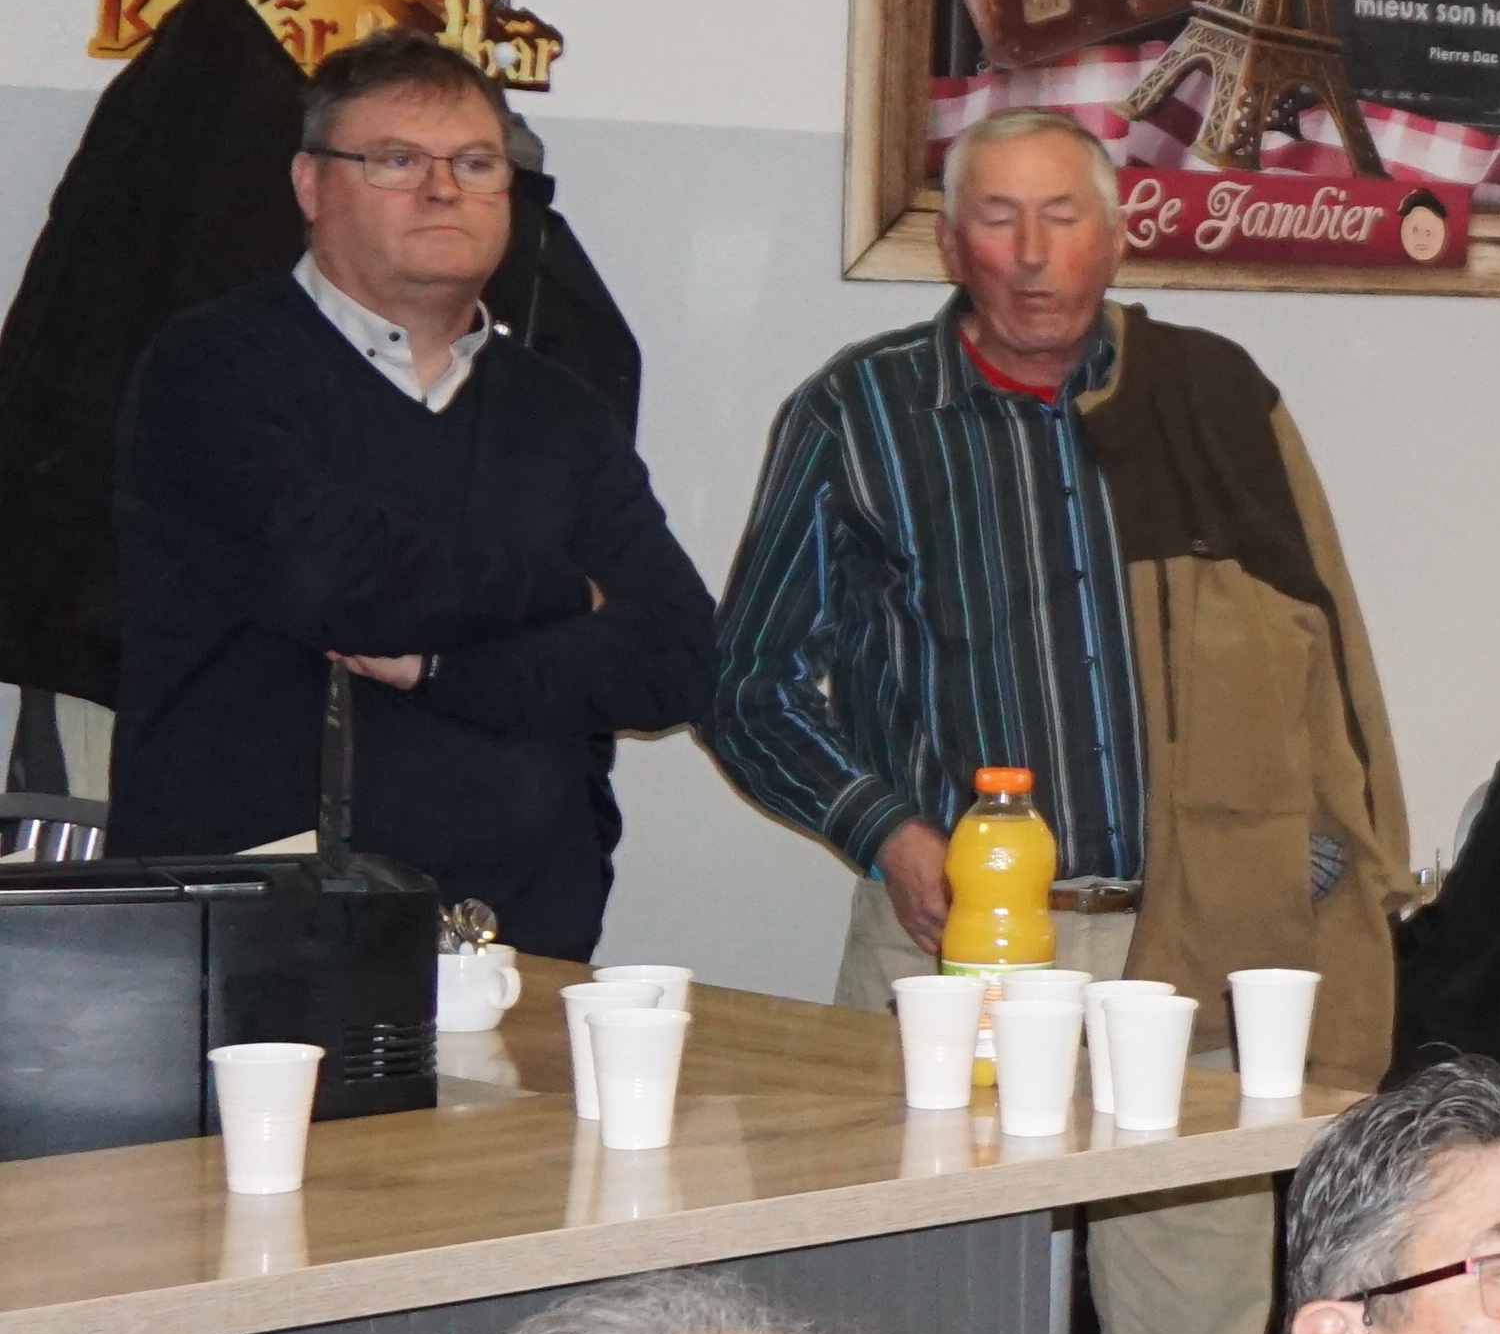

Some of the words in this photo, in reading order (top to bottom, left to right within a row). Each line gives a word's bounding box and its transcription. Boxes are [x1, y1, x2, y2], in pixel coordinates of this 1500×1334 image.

[1436, 3, 1476, 26] son
[1429, 46, 1470, 64] Pierre
[1472, 50, 1499, 65] Dac
[1121, 177, 1183, 249] Le
[1194, 179, 1385, 252] Jambier
